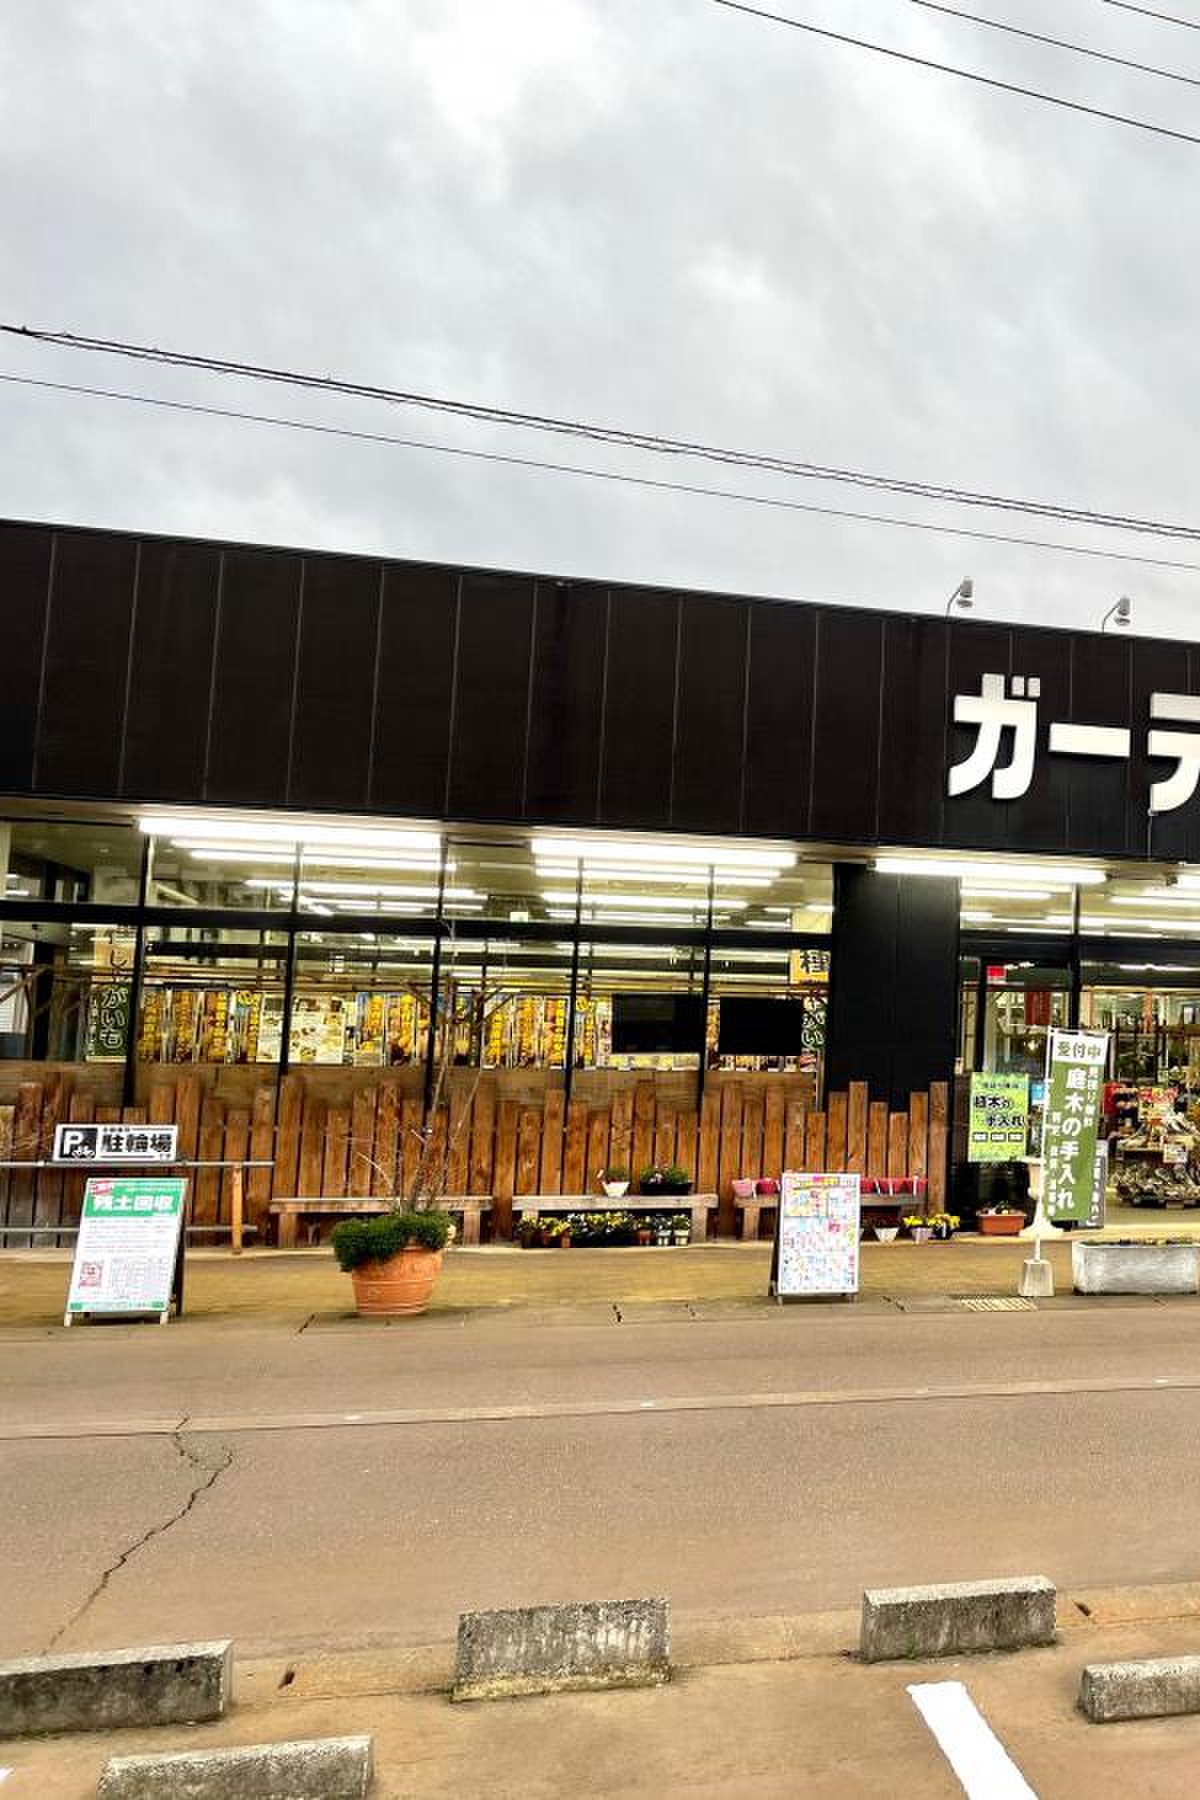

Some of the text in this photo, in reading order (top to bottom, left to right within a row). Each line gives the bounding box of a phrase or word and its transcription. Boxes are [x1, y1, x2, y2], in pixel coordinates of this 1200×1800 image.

[1057, 1041, 1101, 1058] 受付中
[63, 1131, 84, 1155] P
[101, 1133, 172, 1153] 駐輪場
[1056, 1067, 1088, 1210] 庭木の手入れ
